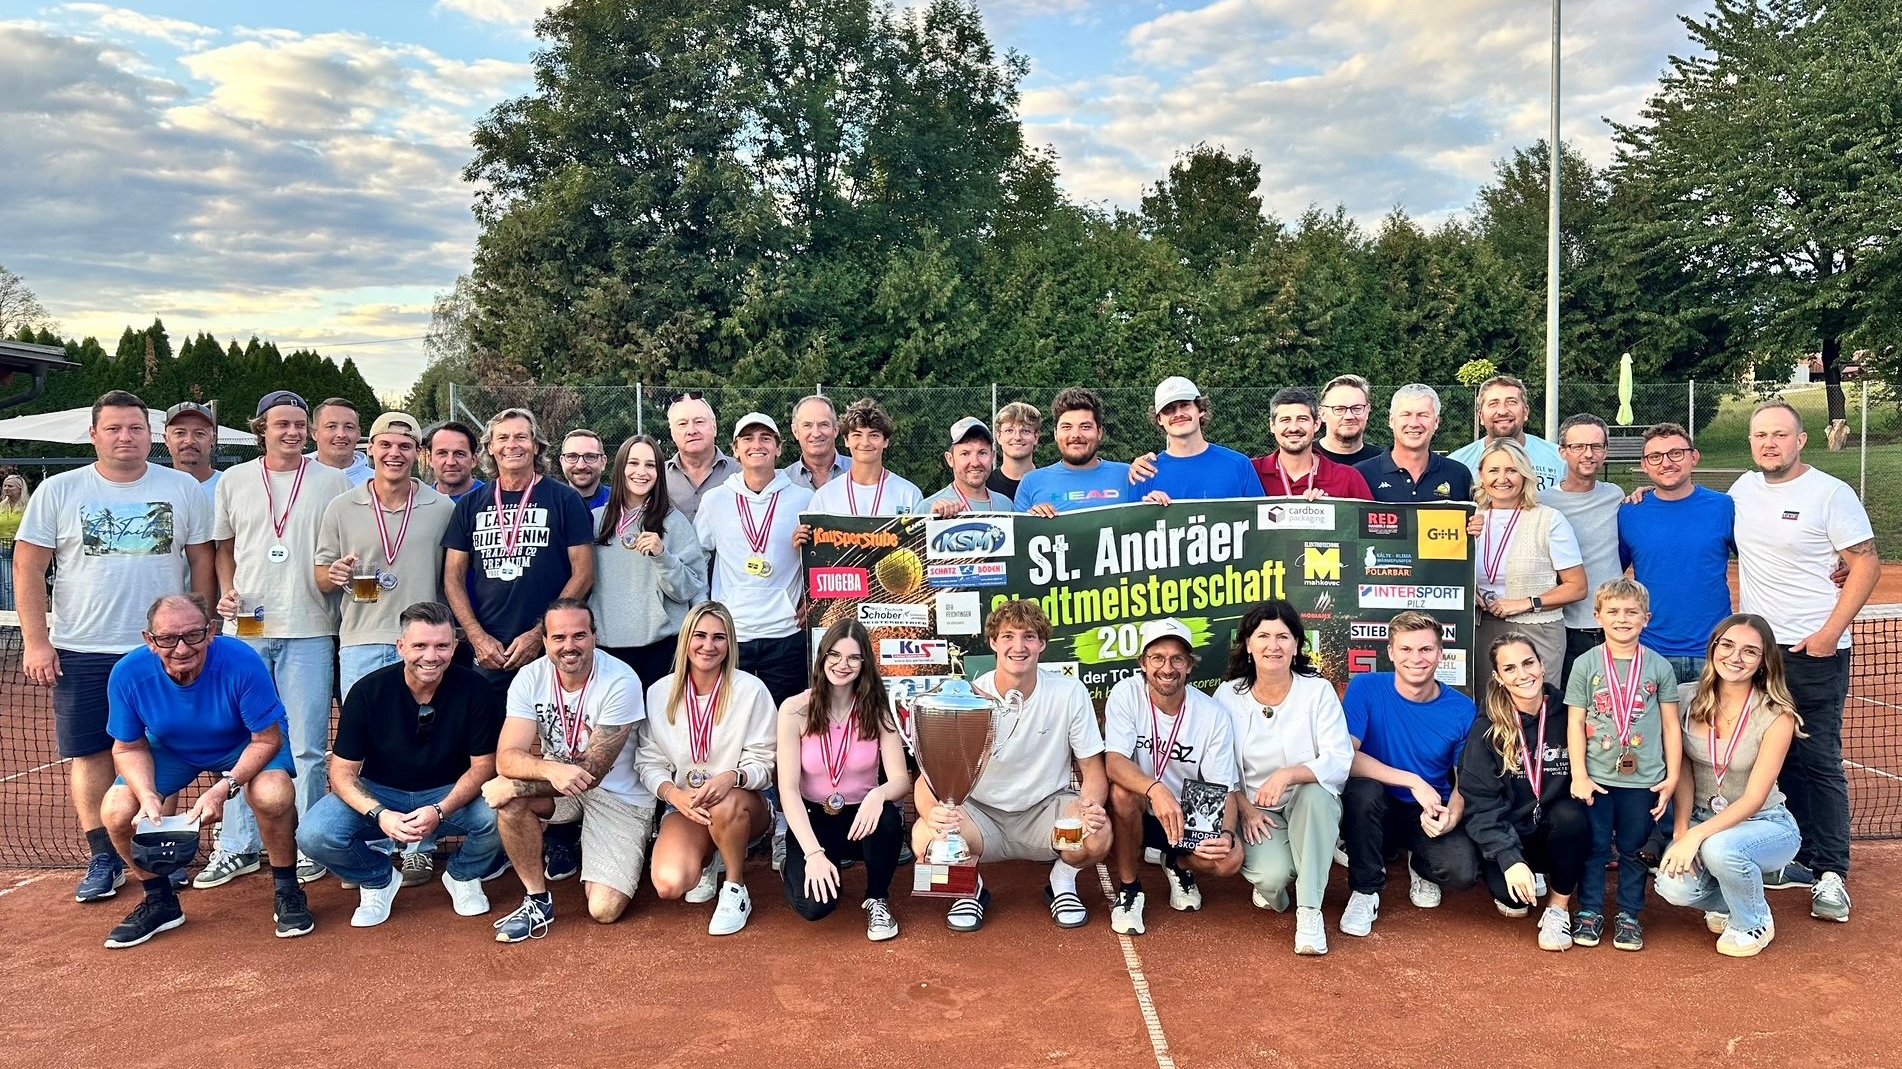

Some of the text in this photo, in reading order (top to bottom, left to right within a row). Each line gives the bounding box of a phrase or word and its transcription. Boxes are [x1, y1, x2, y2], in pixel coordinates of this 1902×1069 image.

[1052, 489, 1119, 502] HEAD
[1289, 506, 1325, 515] cardbox
[1289, 515, 1325, 524] packaging
[1368, 512, 1398, 525] RED
[474, 532, 502, 547] BLUE
[939, 530, 991, 552] KSM
[481, 547, 523, 558] TRADNG
[1028, 515, 1250, 585] St. Andräer
[930, 567, 957, 575] SCHATZ
[817, 573, 861, 592] STUGEBA
[991, 560, 1286, 628] Sdtmeisterschaft
[1374, 586, 1460, 598] INTERSPORT
[1408, 600, 1426, 608] PILZ
[860, 605, 902, 619] Schober
[1351, 625, 1387, 637] STIEB
[1097, 622, 1148, 660] 20
[1083, 670, 1108, 684] der
[1109, 667, 1130, 683] TC
